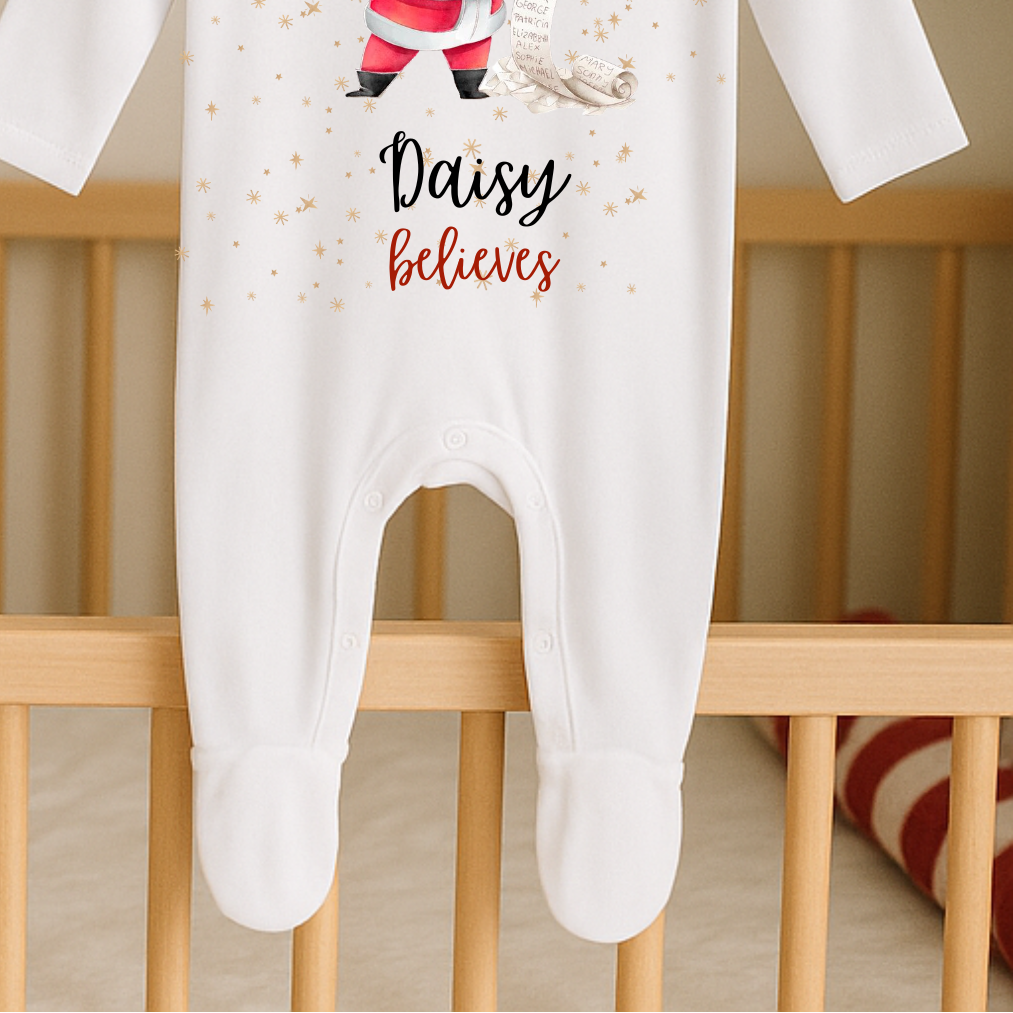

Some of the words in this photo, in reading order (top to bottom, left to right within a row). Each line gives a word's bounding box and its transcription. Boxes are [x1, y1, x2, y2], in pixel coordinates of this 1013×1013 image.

[515, 40, 541, 51] ALEX
[578, 55, 615, 77] MARY
[379, 130, 572, 227] Daisy
[389, 226, 561, 293] believes
